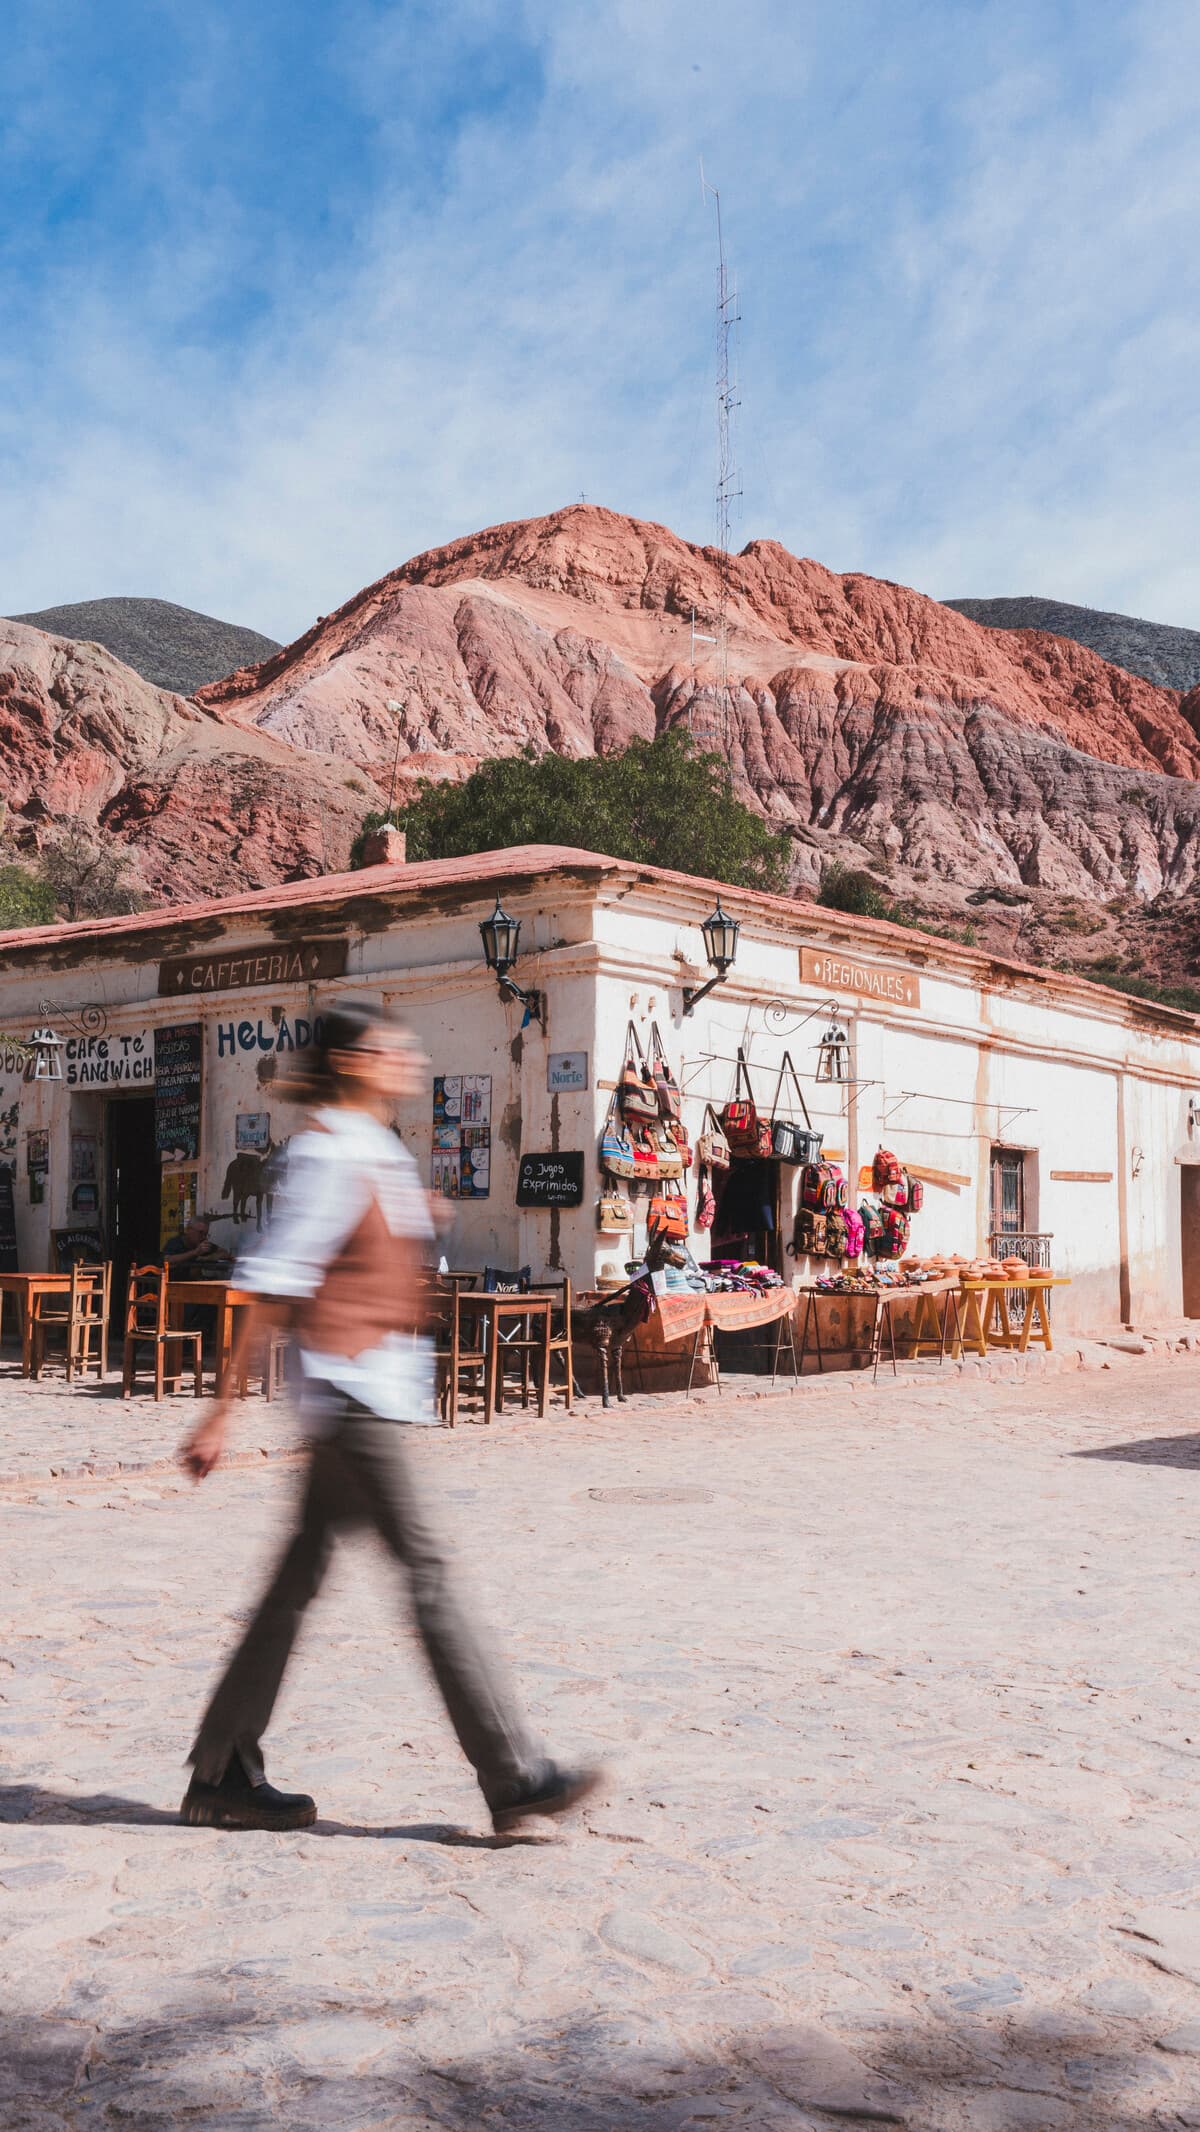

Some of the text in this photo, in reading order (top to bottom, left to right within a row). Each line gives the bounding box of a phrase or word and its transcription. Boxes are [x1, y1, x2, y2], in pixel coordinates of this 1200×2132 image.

[190, 954, 305, 989] CAFETERIA
[822, 959, 905, 1000] REGIONALES
[551, 1071, 582, 1084] Norte
[537, 1163, 564, 1179] Jugos
[522, 1178, 578, 1194] Exprimidos
